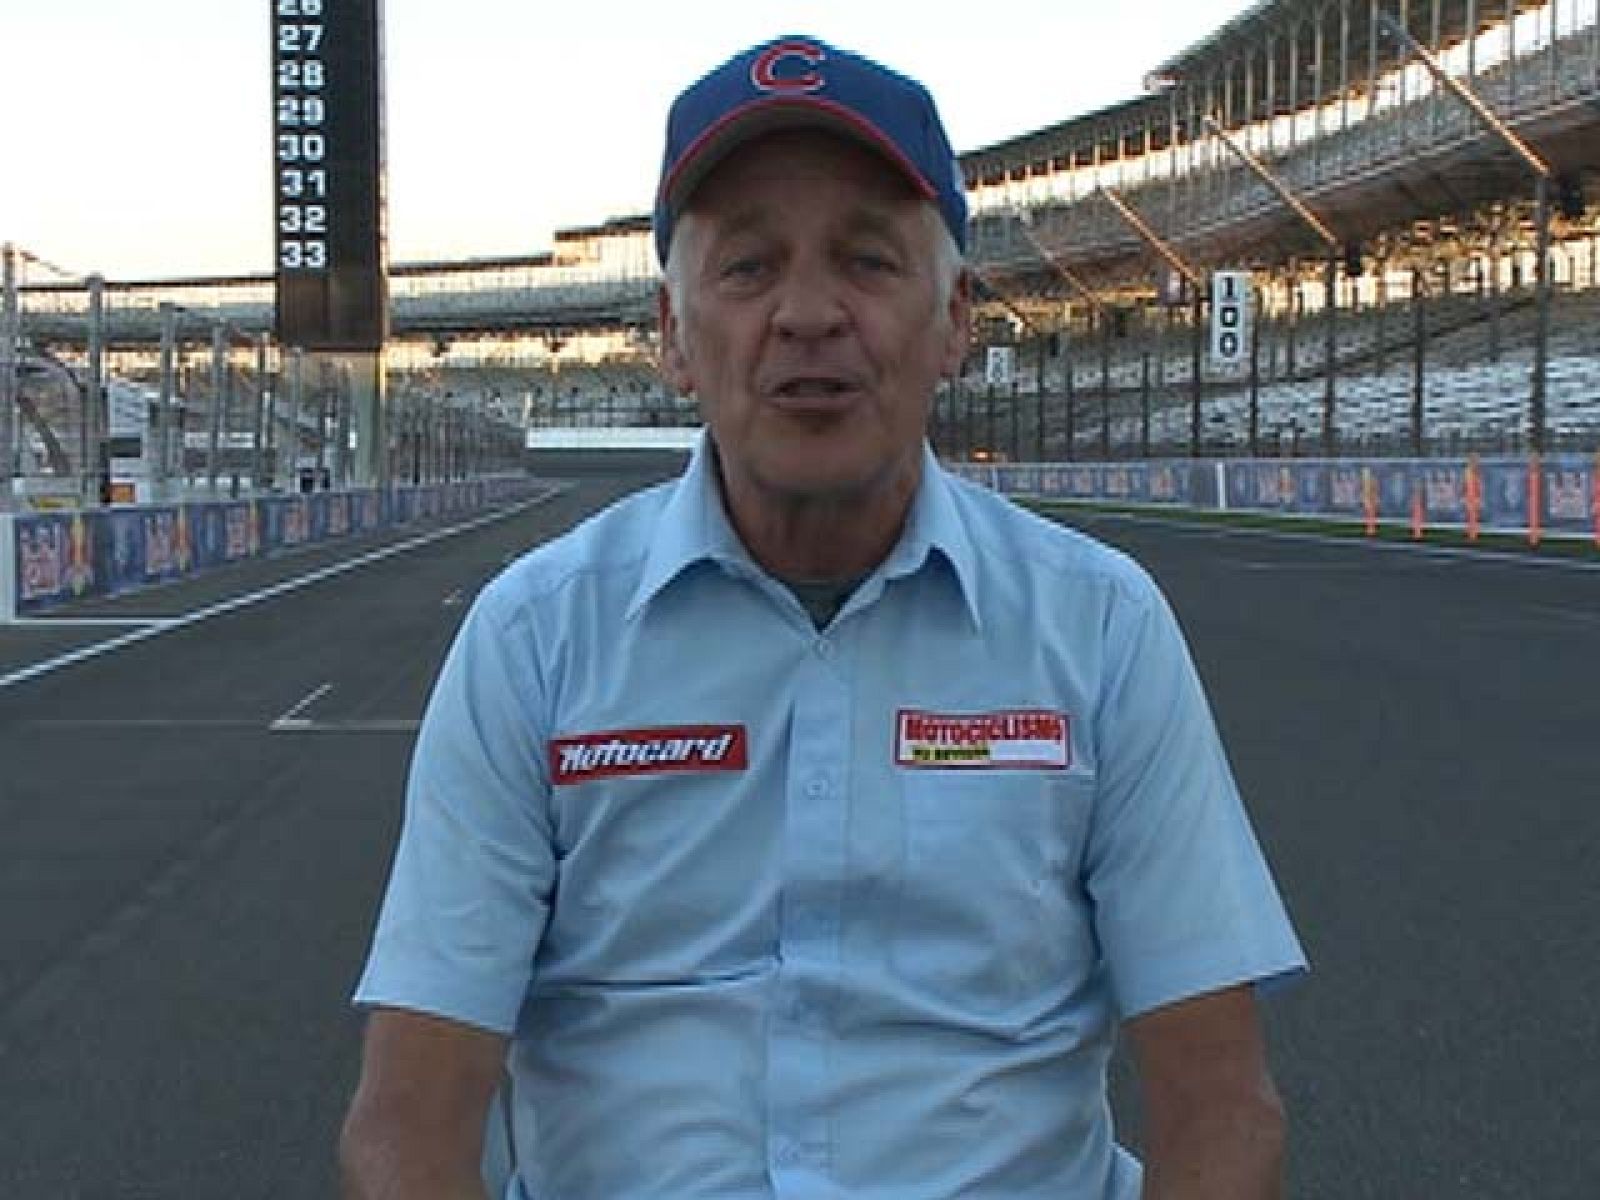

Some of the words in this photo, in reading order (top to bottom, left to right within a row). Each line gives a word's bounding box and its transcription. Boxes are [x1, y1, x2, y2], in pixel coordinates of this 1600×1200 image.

[278, 24, 325, 51] 27
[278, 59, 325, 86] 28
[752, 41, 825, 91] C
[278, 95, 325, 125] 29
[278, 134, 325, 161] 30
[279, 169, 326, 196] 31
[279, 204, 327, 233] 32
[279, 240, 327, 268] 33
[1218, 275, 1240, 357] 100
[559, 734, 733, 776] Motocard
